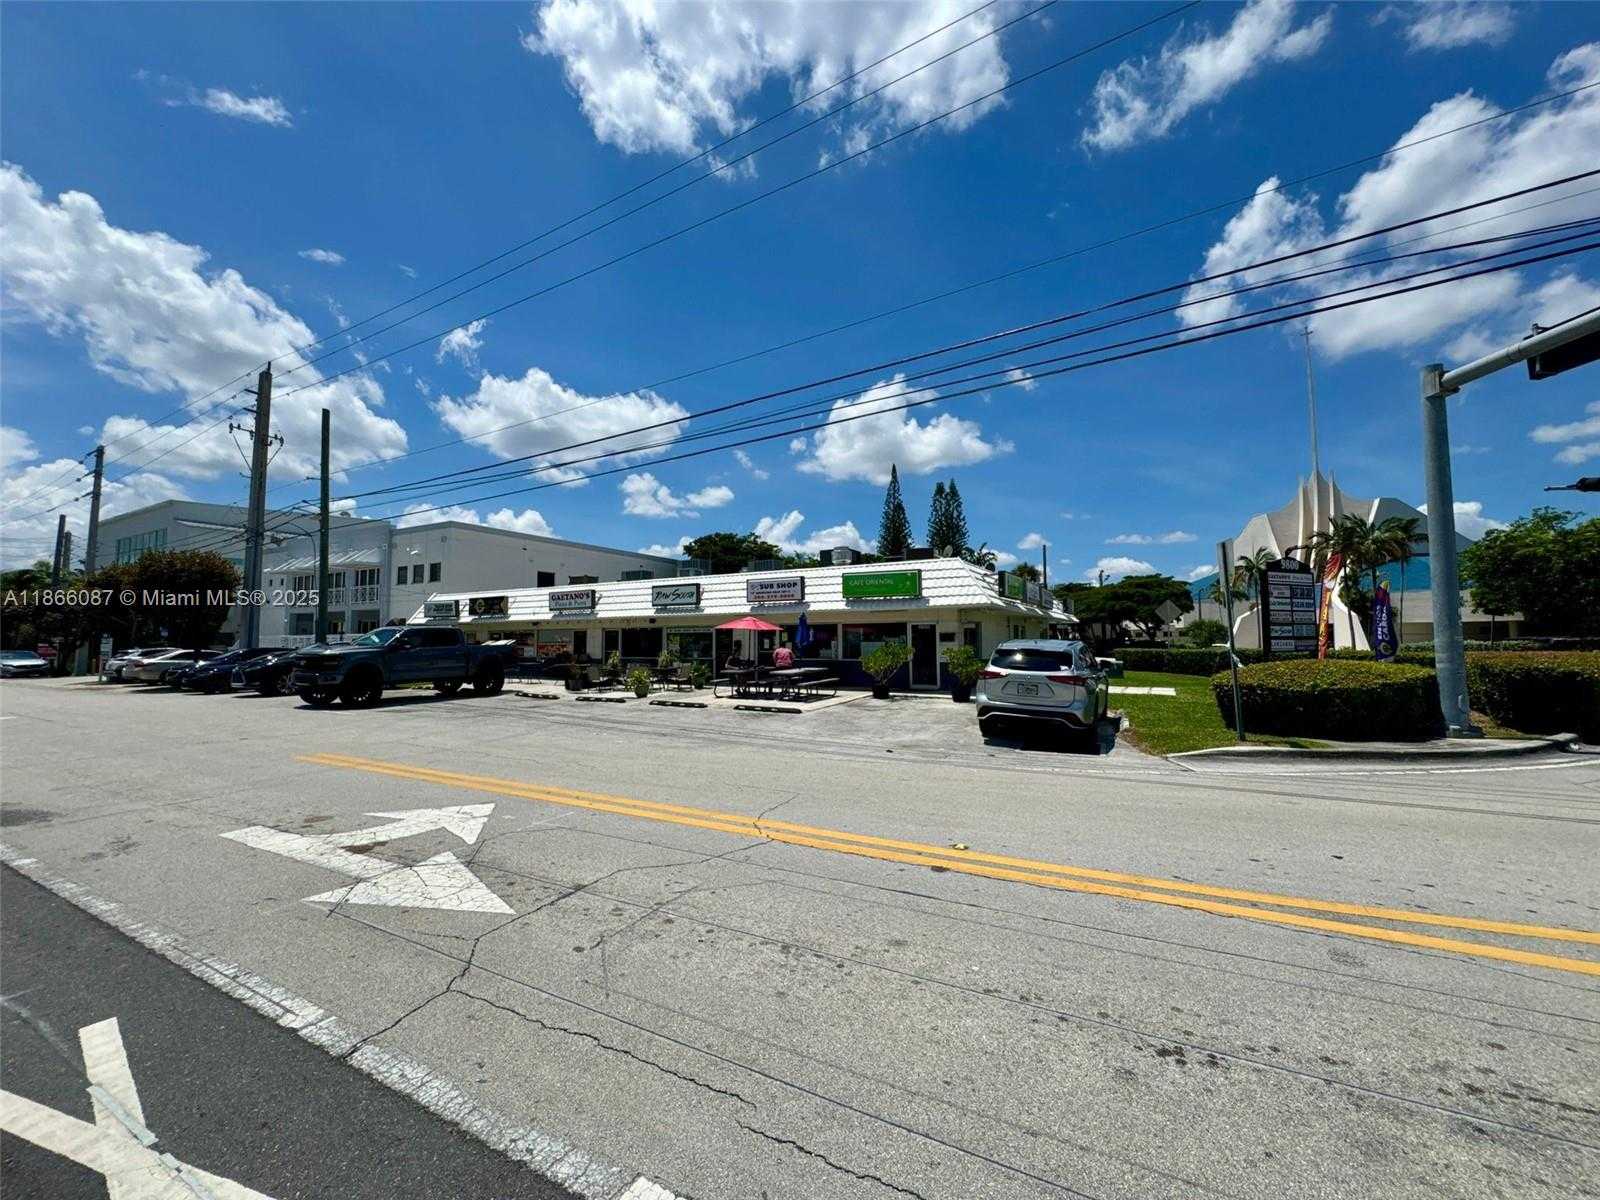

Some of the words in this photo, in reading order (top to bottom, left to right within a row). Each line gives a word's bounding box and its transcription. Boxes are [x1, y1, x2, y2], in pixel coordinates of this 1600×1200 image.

[1281, 559, 1299, 570] 9800
[759, 582, 775, 590] SUB
[776, 581, 798, 589] SHOP
[551, 591, 590, 601] GAETANO'S
